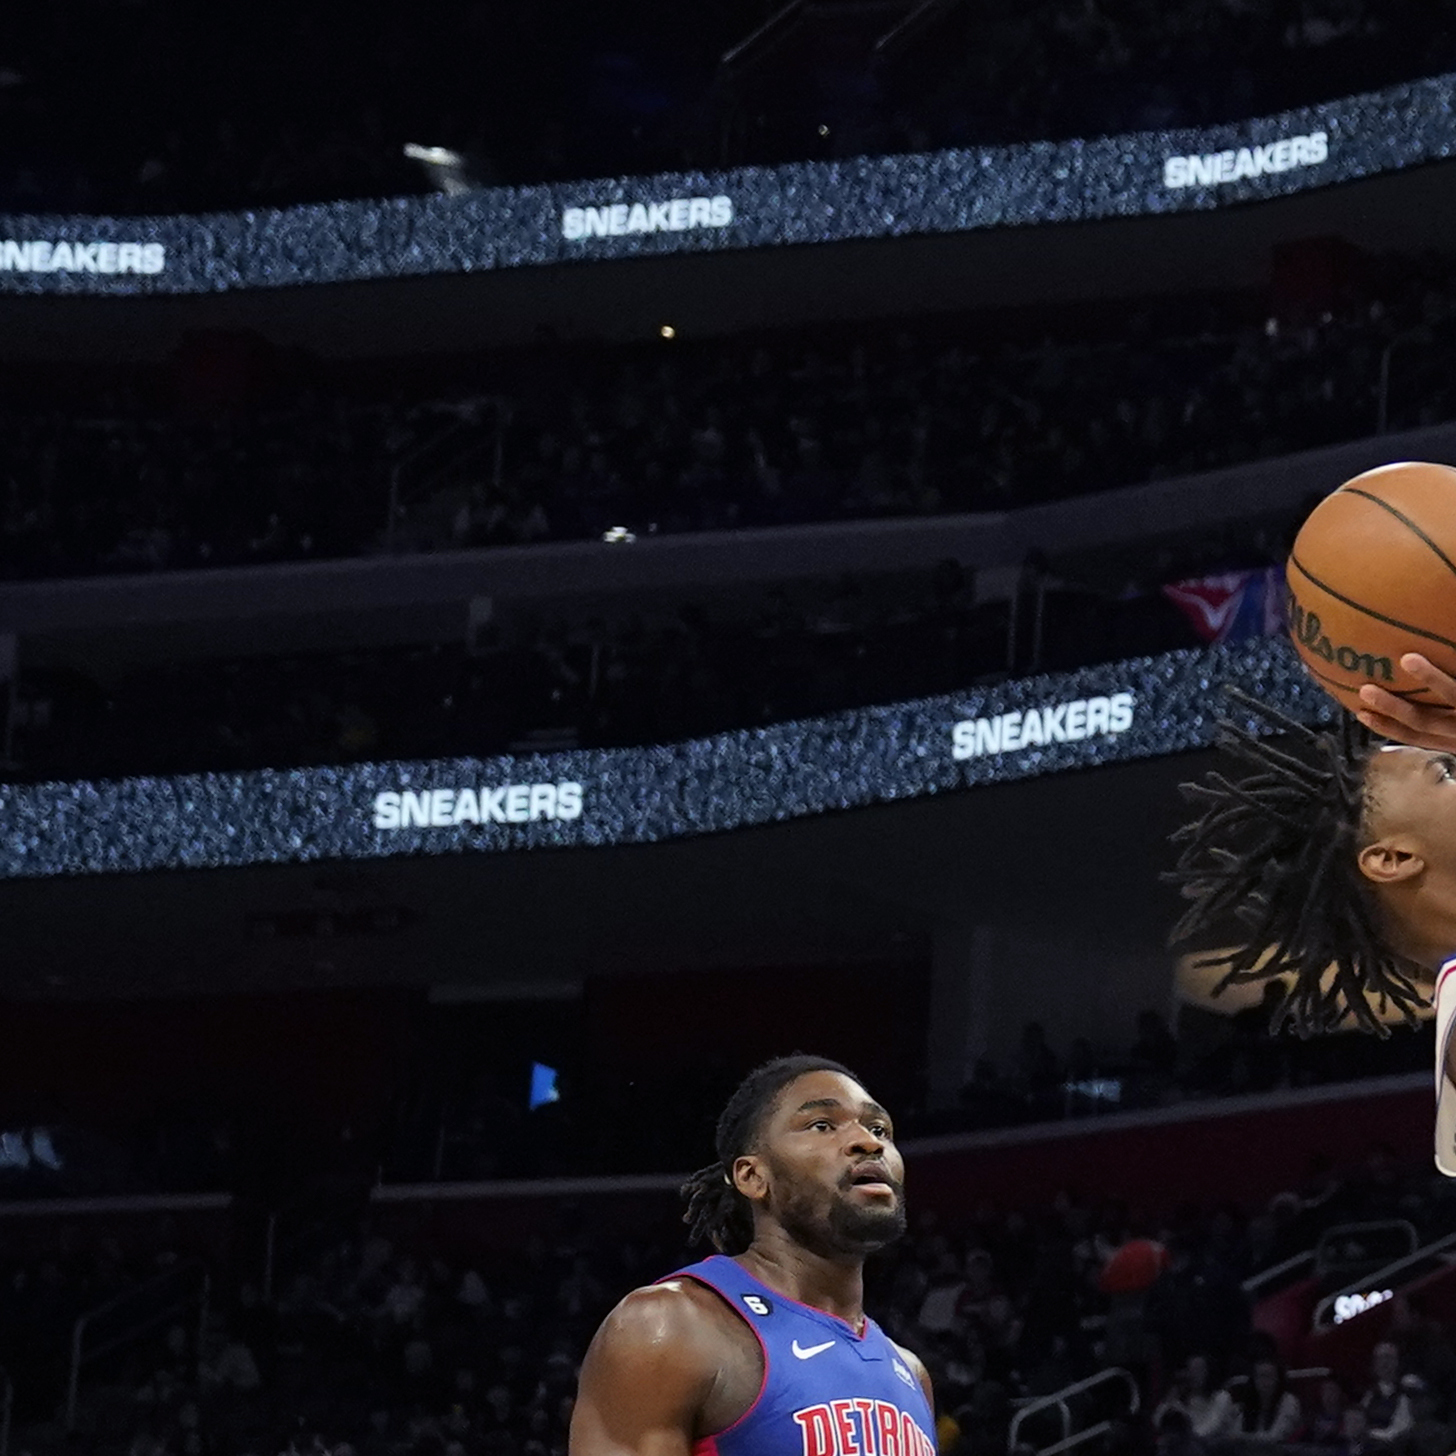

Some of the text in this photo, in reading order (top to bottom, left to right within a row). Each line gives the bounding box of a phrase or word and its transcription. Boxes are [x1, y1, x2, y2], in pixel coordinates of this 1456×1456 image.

[1164, 132, 1329, 188] SNEAKERS
[563, 196, 733, 241] SNEAKERS
[0, 240, 165, 274] NEAKERS
[953, 692, 1133, 761] SNEAKERS
[375, 782, 583, 830] SNEAKERS
